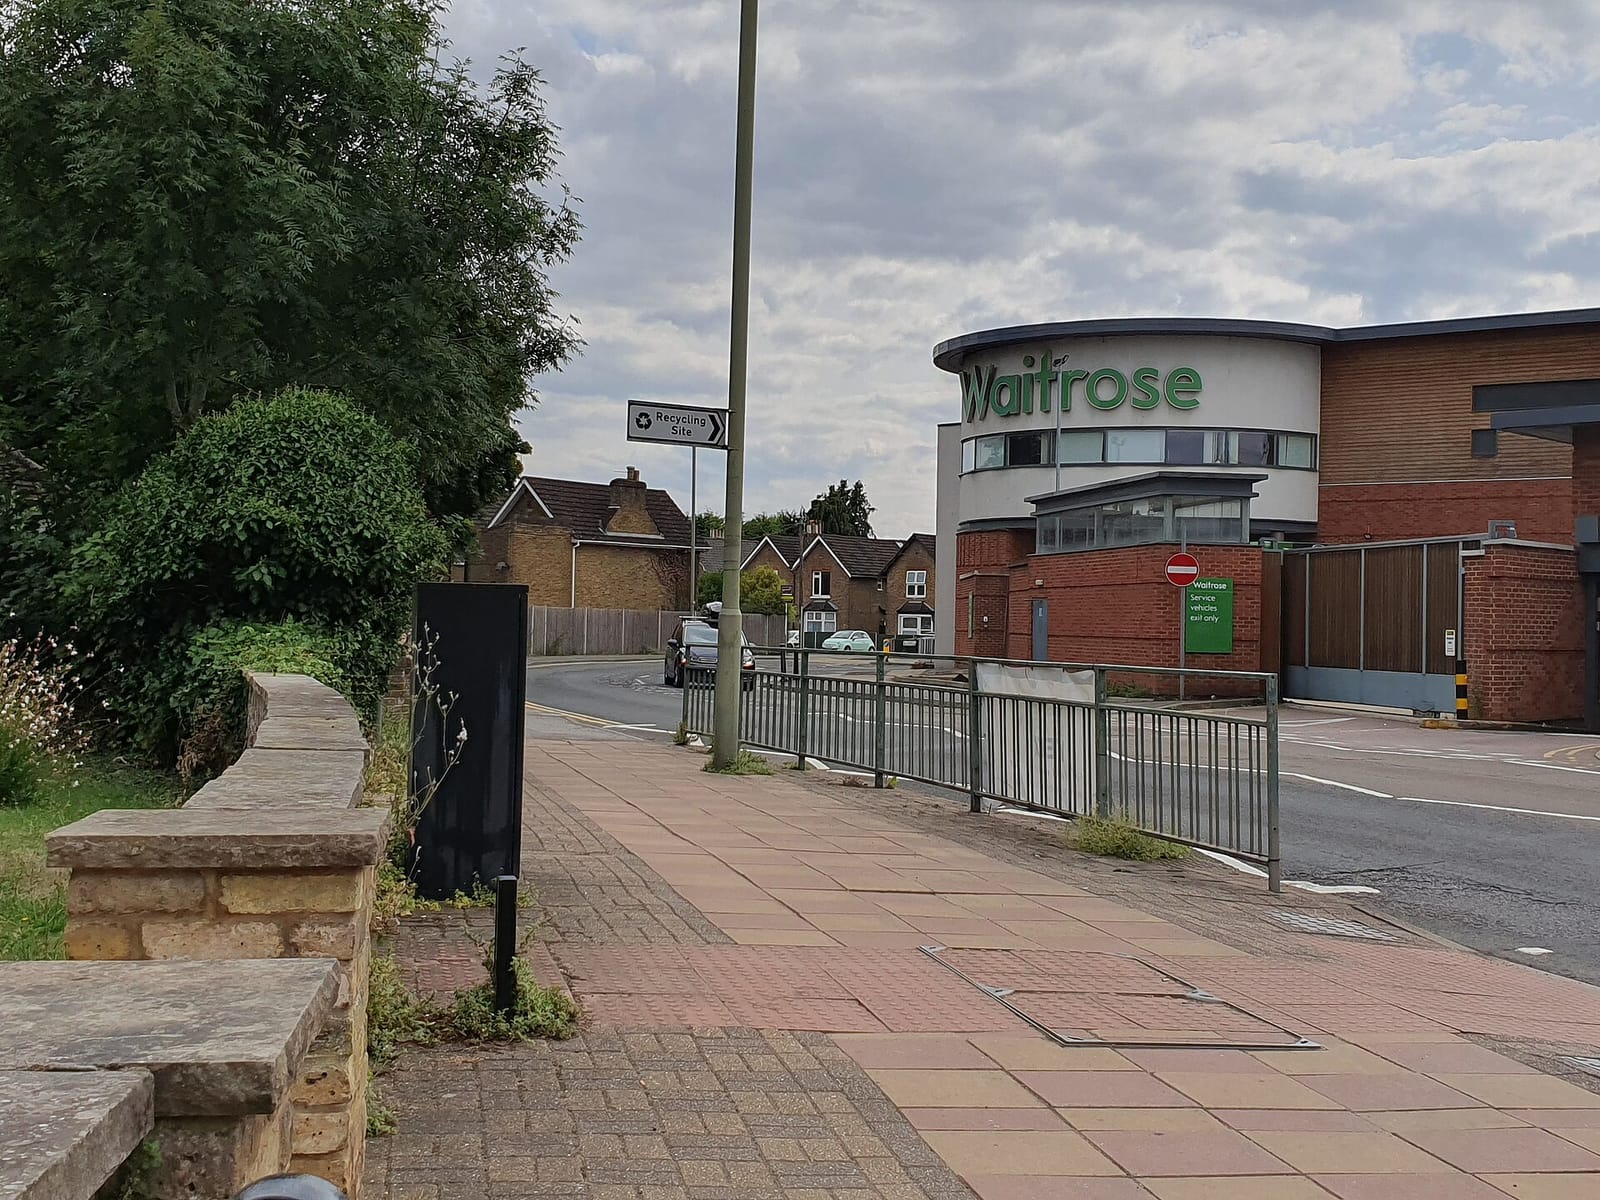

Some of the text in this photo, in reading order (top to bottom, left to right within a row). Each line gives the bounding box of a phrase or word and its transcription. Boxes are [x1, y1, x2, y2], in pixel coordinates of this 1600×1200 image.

[960, 351, 1202, 422] Waitrose
[656, 411, 706, 427] Recycling
[671, 425, 692, 436] Site
[1193, 581, 1227, 590] Waitrose
[1203, 615, 1219, 623] only
